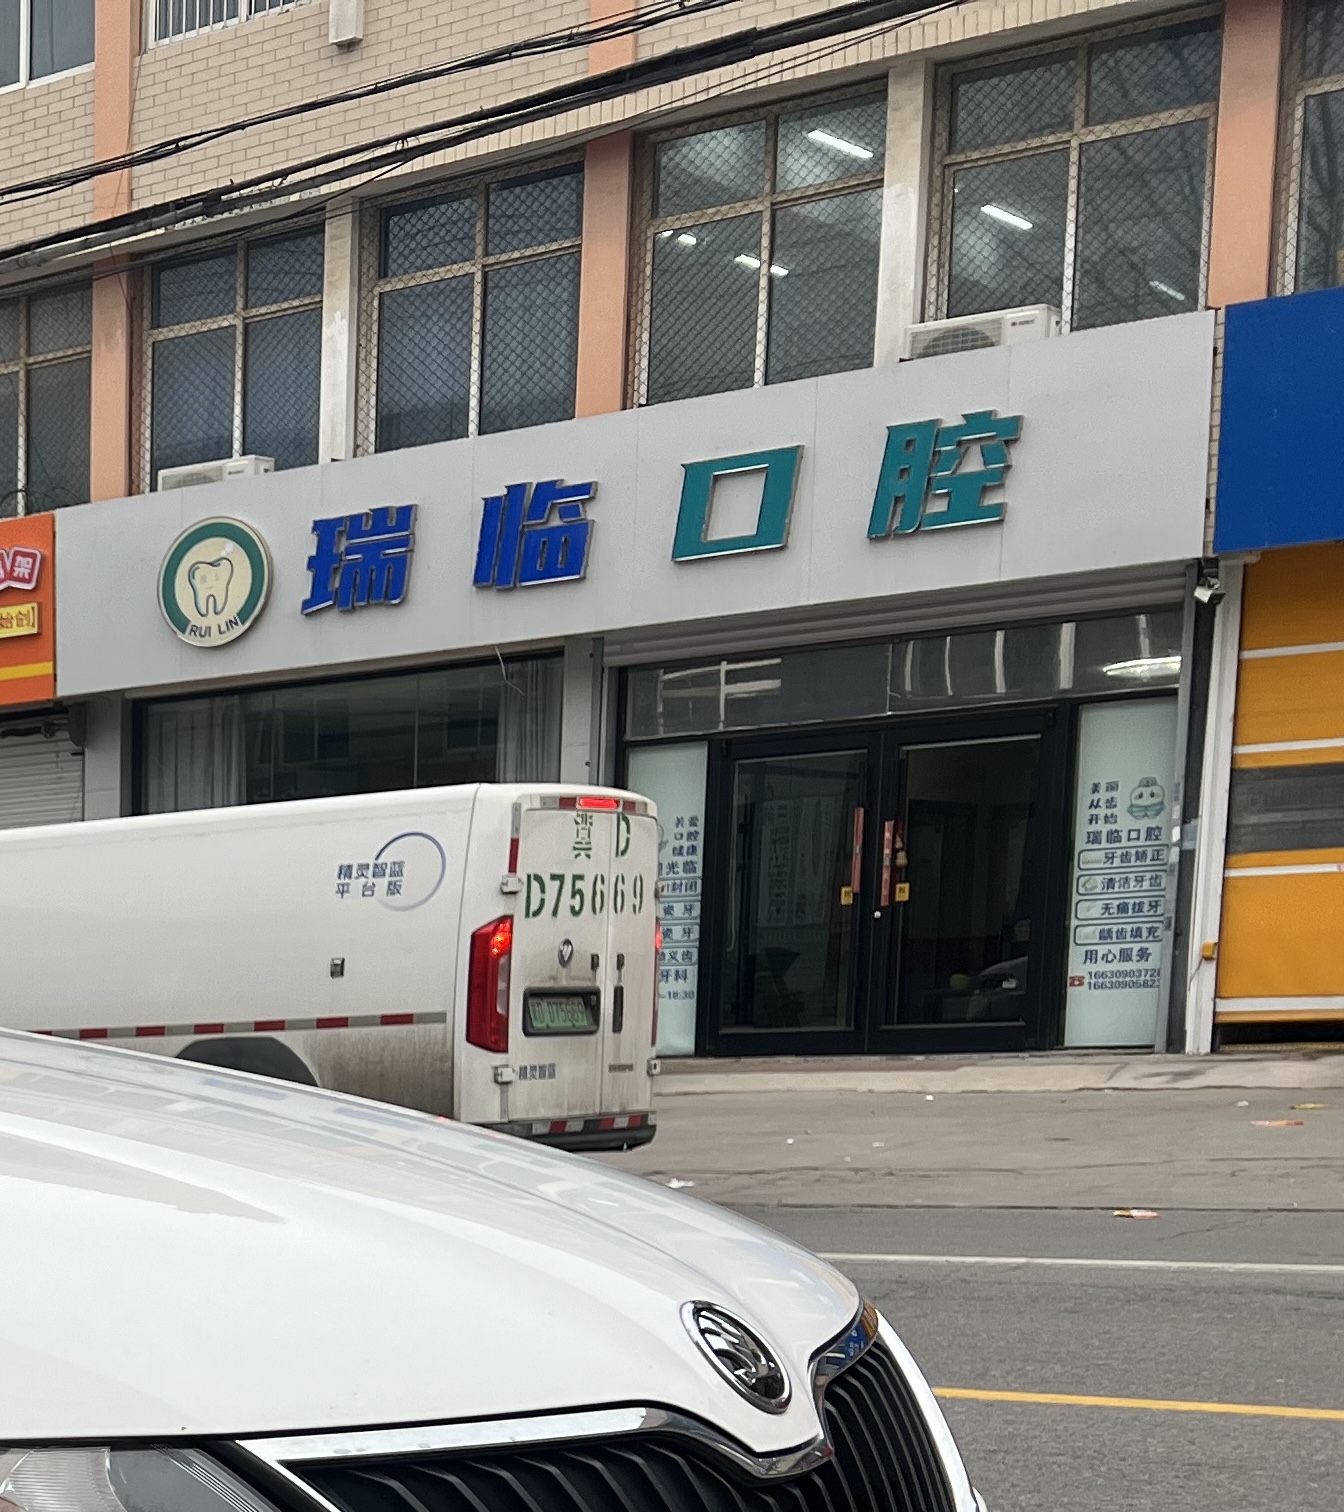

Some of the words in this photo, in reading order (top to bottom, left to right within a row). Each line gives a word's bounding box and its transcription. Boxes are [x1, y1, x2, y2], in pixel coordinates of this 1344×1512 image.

[301, 410, 1023, 616] 瑞临口腔
[188, 624, 212, 638] RUI
[217, 615, 240, 636] LIN
[615, 812, 631, 858] D
[1085, 825, 1163, 845] 瑞临口腔
[525, 872, 644, 919] D75669
[1083, 946, 1153, 965] 用心服务
